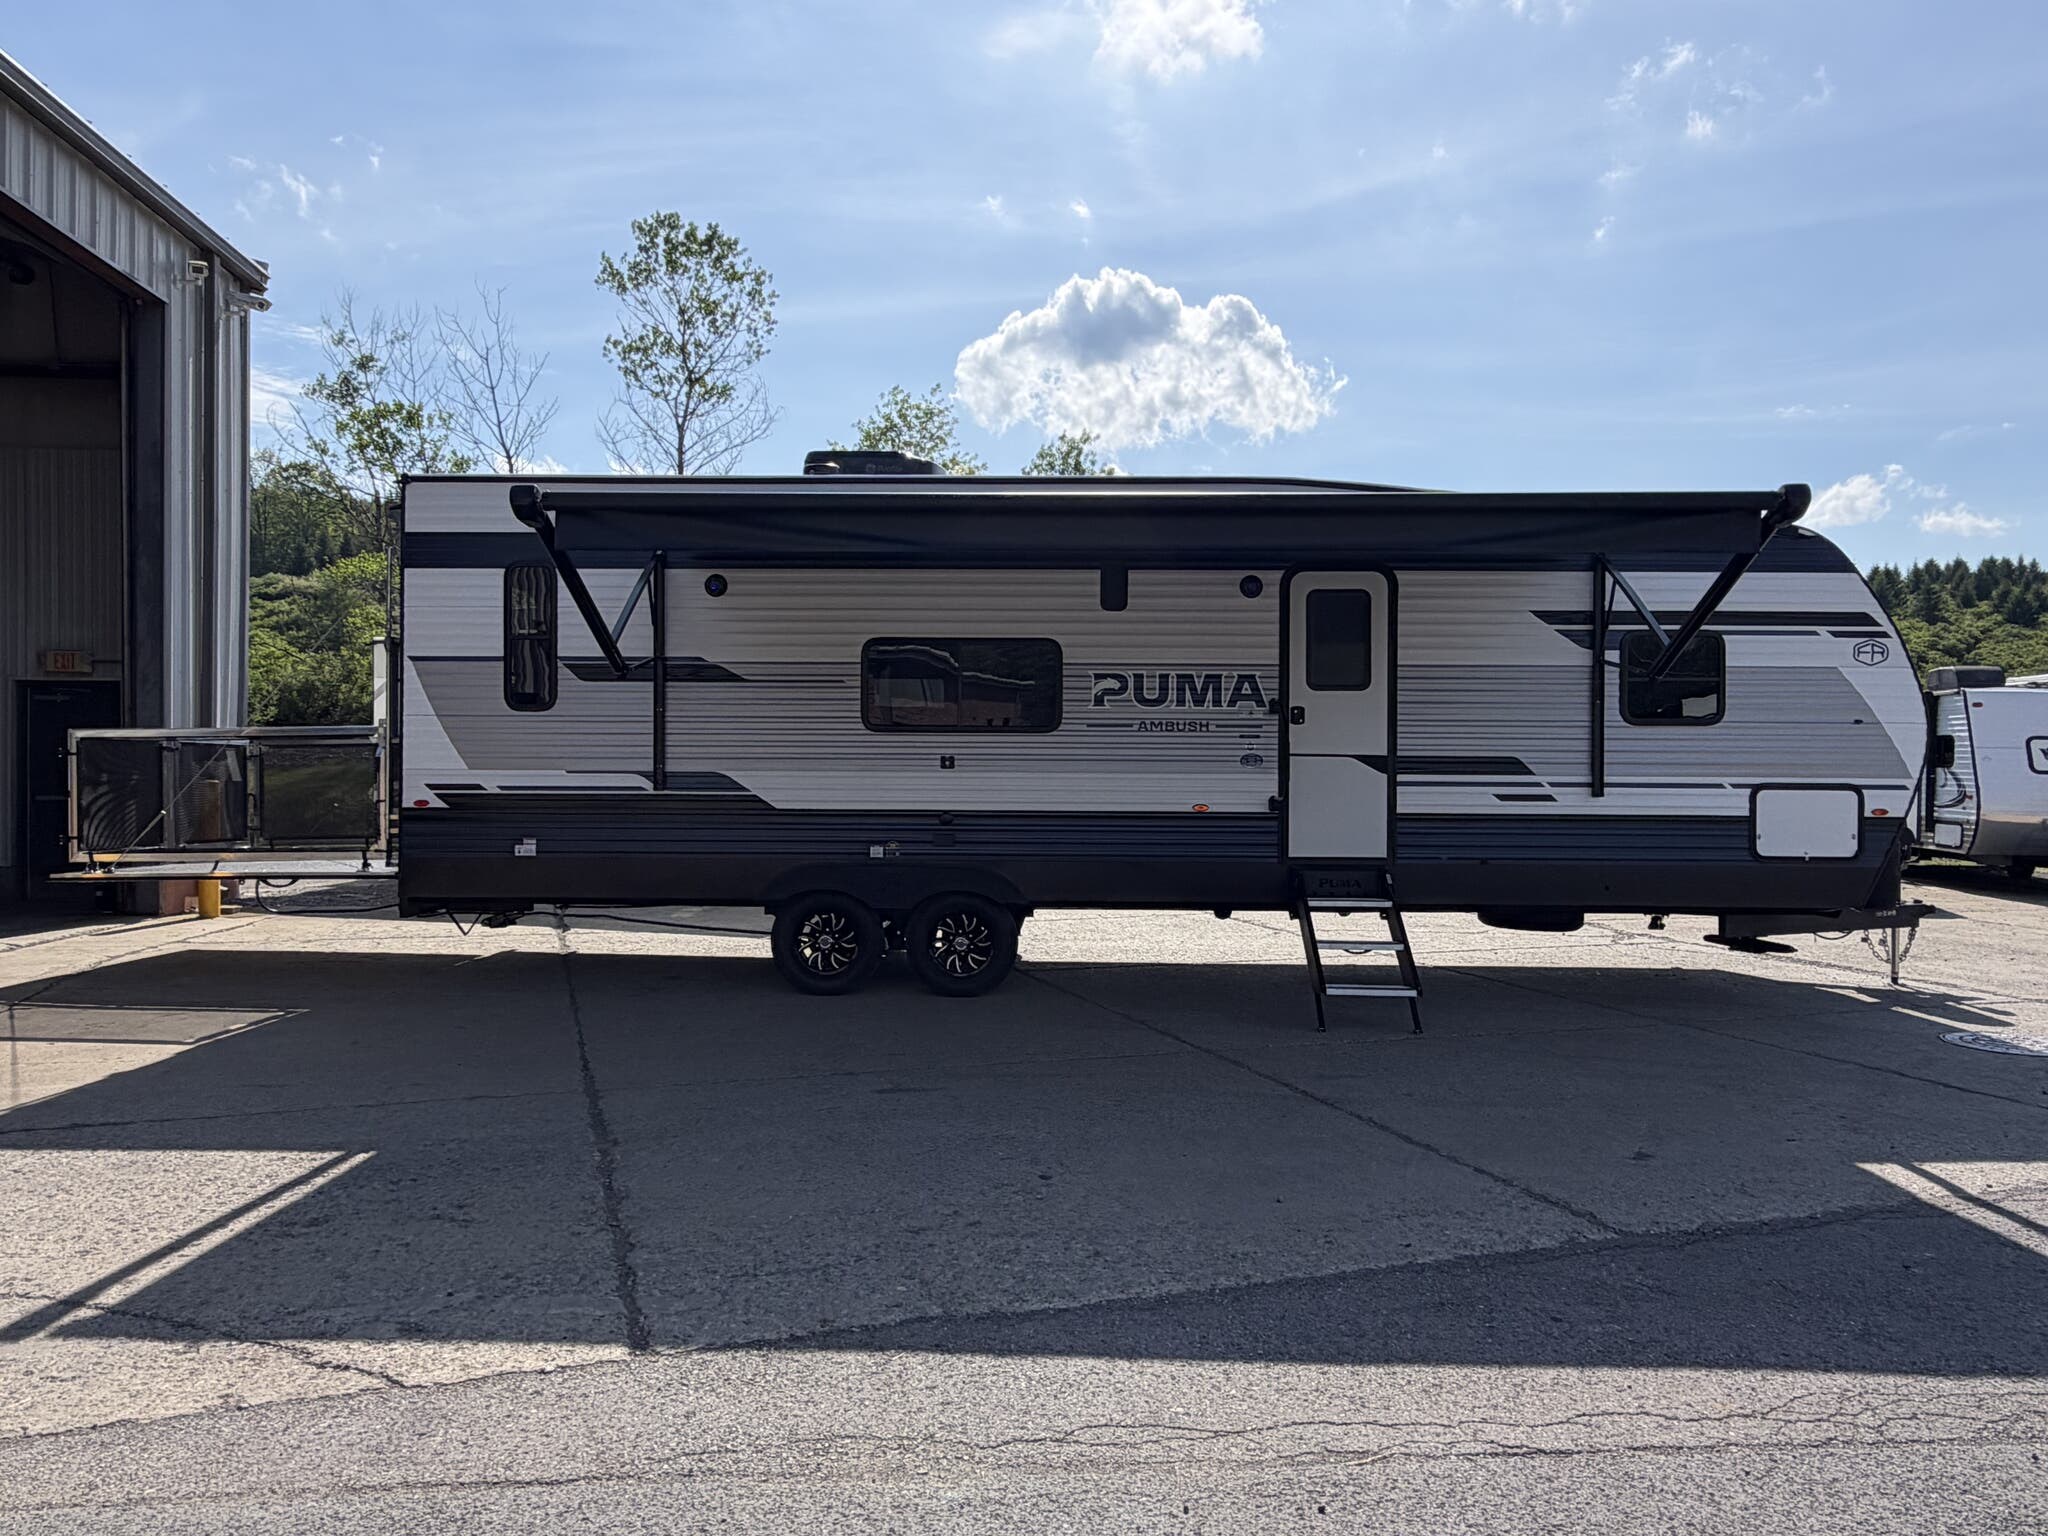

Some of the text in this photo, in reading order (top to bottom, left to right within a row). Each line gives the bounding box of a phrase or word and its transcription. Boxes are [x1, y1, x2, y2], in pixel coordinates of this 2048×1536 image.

[1089, 671, 1269, 709] PUMA
[1137, 721, 1210, 732] AMBUSH
[1319, 878, 1362, 888] PUMA
